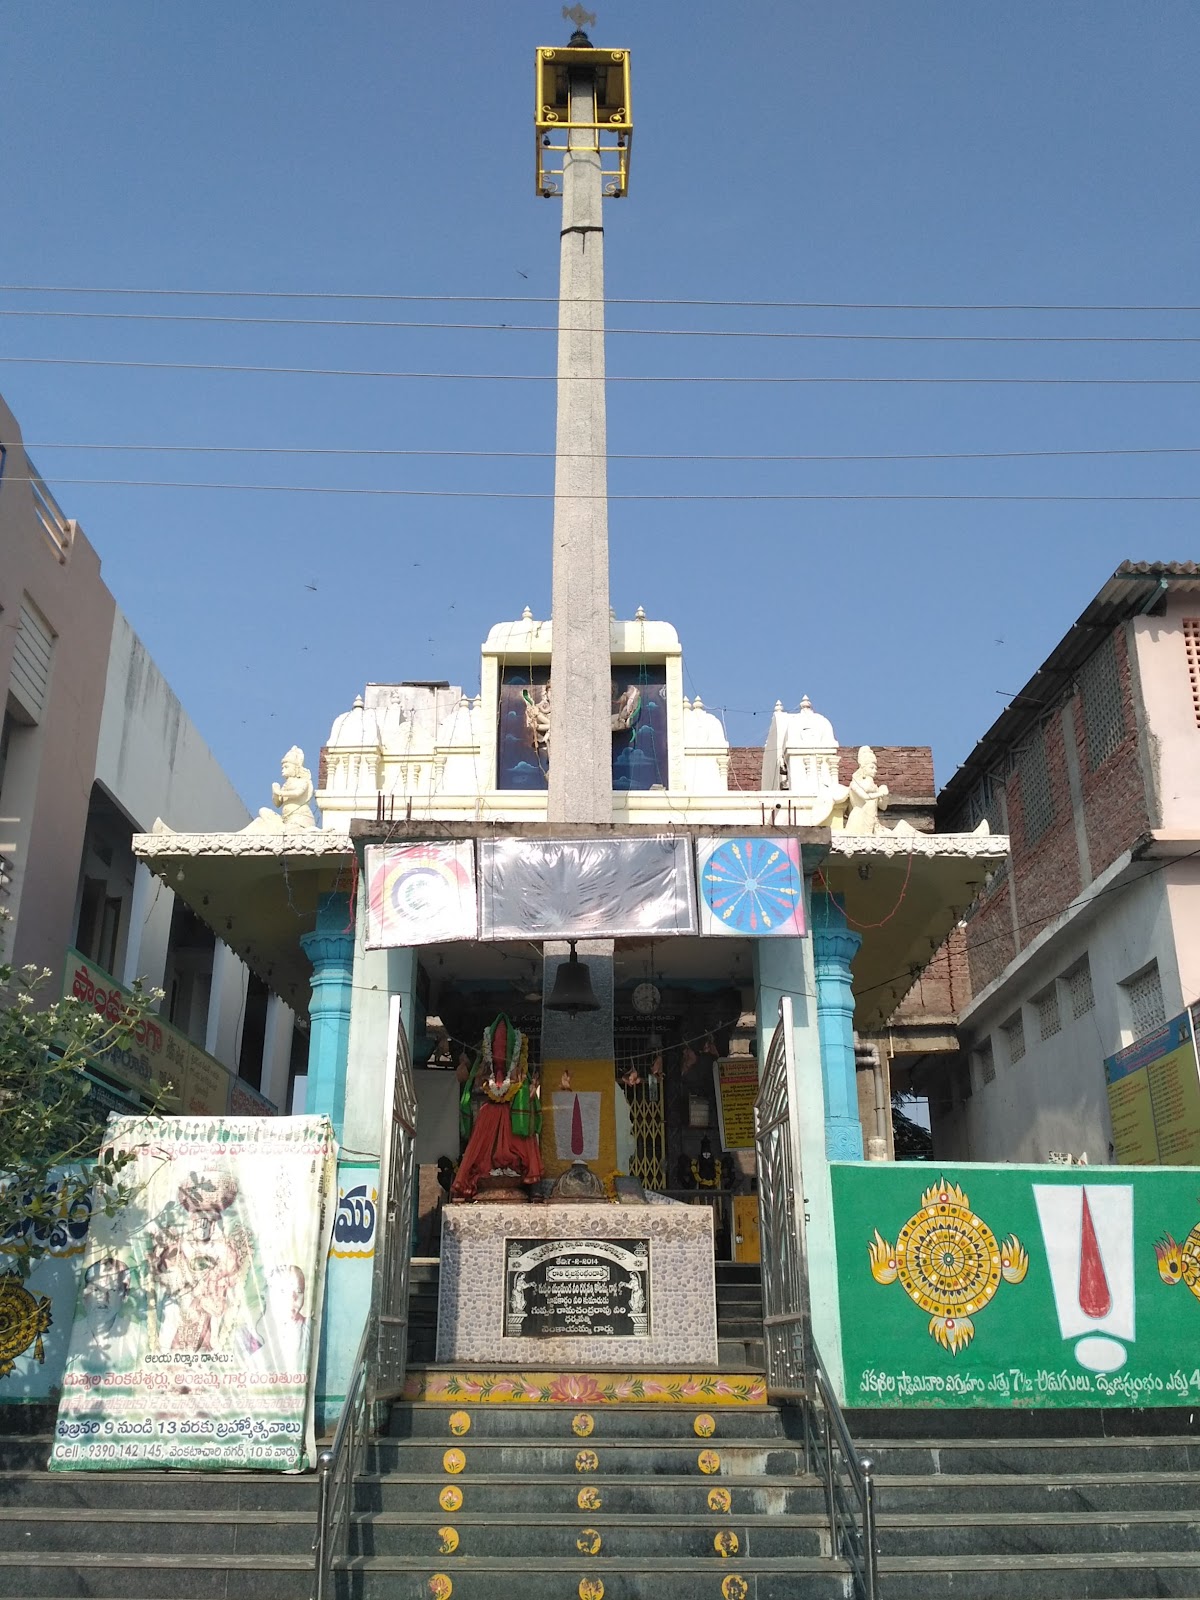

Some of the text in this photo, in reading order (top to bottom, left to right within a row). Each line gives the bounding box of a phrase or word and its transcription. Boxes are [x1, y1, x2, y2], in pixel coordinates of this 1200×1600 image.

[145, 1353, 172, 1363] ఆలయ
[174, 1353, 199, 1367] నిర్మాణ
[64, 1372, 102, 1390] గువ్వల
[174, 1372, 220, 1389] అంజమ్మ
[222, 1371, 247, 1389] గార్ల
[250, 1372, 308, 1385] దంపతులు
[946, 1372, 985, 1395] విగ్రహం
[988, 1372, 1011, 1397] ఎత్తు
[1166, 1369, 1189, 1397] ఎత్తు
[58, 1417, 301, 1439] ఫిబ్రవరి 9 నుండి 13 వరకు బ్రహ్మోత్సవాలు
[55, 1444, 79, 1458] Cell
[88, 1444, 116, 1458] 9390
[119, 1444, 139, 1457] 142
[169, 1445, 222, 1458] వెంకటాచారి
[250, 1446, 263, 1458] 10
[265, 1446, 273, 1458] వ
